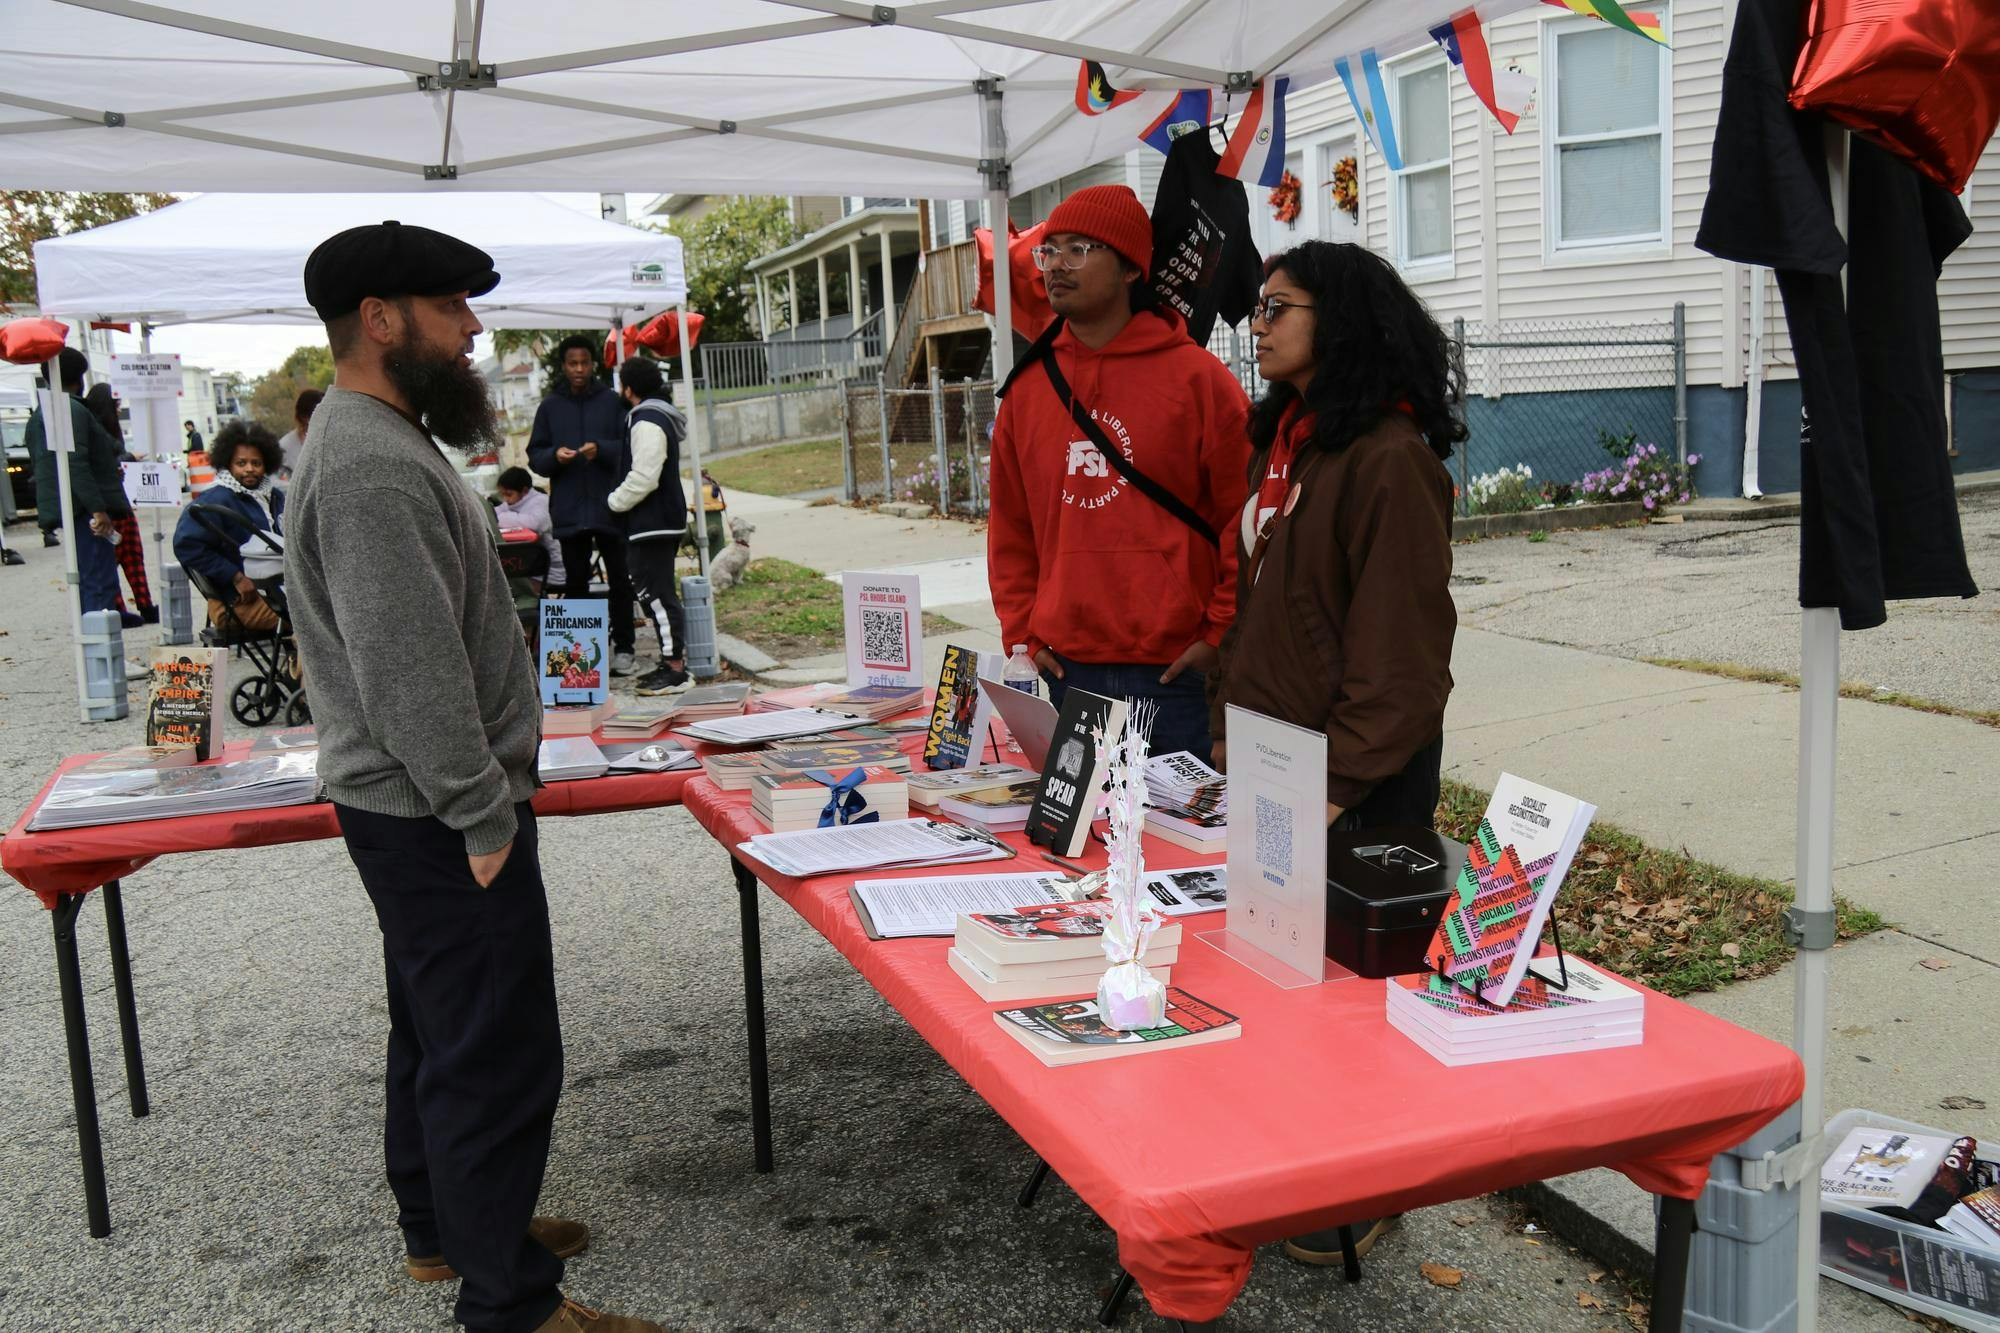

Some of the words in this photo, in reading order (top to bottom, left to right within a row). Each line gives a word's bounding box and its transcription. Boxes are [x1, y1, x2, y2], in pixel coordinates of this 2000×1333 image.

[1090, 409, 1099, 420] &
[1067, 450, 1109, 477] PSL
[141, 473, 160, 486] EXIT
[1079, 486, 1120, 509] PARTY
[859, 592, 869, 602] PSL
[870, 593, 887, 602] RHODE
[887, 594, 906, 603] ISLAND
[863, 585, 890, 593] DONATE
[545, 605, 567, 617] PAN-
[544, 617, 602, 629] AFRICANISM
[154, 661, 208, 673] HARVEST
[172, 676, 188, 685] OF
[158, 688, 201, 699] EMPIRE
[924, 648, 961, 758] WOMEN
[167, 724, 190, 733] JUAN
[942, 730, 957, 743] Fight
[957, 734, 971, 746] Back
[1045, 776, 1077, 807] SPEAR
[1520, 795, 1547, 813] SOCIALIST
[1507, 803, 1552, 829] RECONSTRUCTION
[1480, 817, 1502, 854] SOCIALIST
[1504, 843, 1528, 881] SOCIALIST
[1263, 869, 1285, 887] venmo
[1478, 901, 1517, 922] SOCIALIST
[1449, 910, 1472, 948] SOCIALIST
[1437, 920, 1455, 957] OCIALIST
[1453, 938, 1517, 966] RECONSTRUCTION
[1451, 964, 1489, 983] SOCIALIST
[1413, 992, 1460, 1008] SOCIALIST
[1423, 988, 1505, 1013] RECONSTRUCTION
[1837, 1181, 1868, 1190] BLACK
